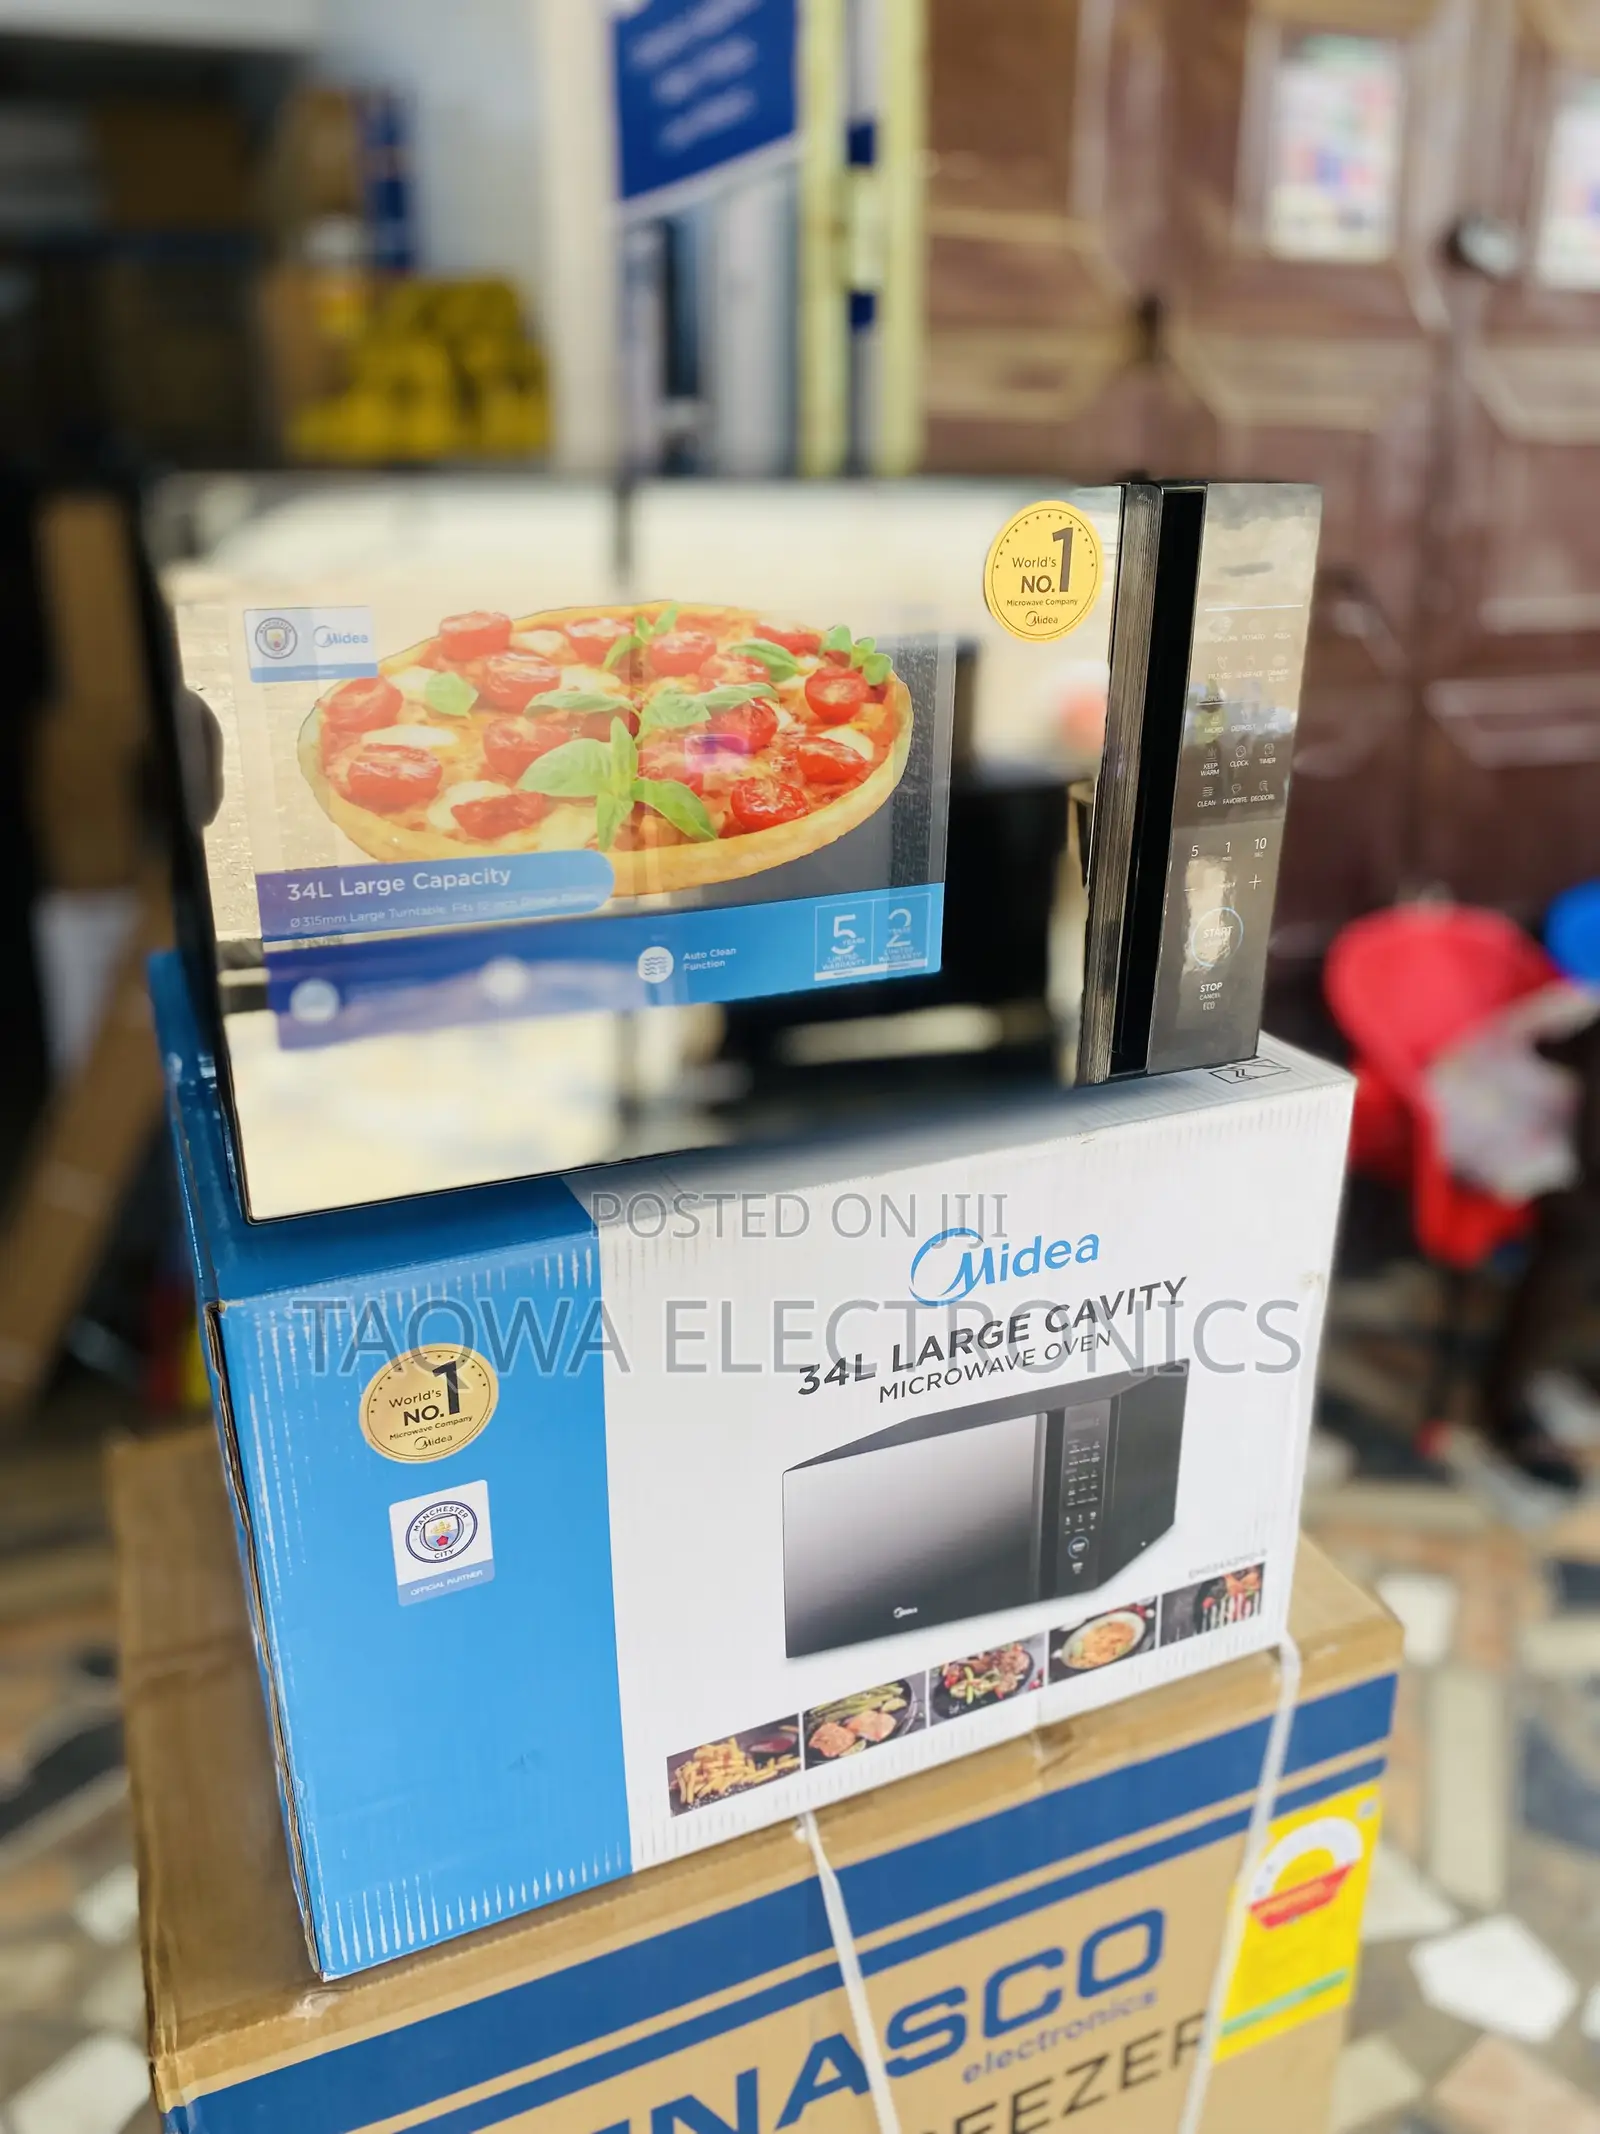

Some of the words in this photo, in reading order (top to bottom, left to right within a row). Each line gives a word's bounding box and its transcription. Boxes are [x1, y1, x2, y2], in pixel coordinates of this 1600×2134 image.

[1012, 557, 1057, 568] World's
[1021, 575, 1055, 594] NO.
[1052, 527, 1074, 593] 1
[1006, 599, 1043, 607] Microwave
[1045, 598, 1078, 606] Company
[1025, 610, 1058, 627] Midea
[1229, 760, 1250, 768] CLOCK
[1197, 800, 1217, 808] CLEAN
[1223, 796, 1248, 804] FAVORITE
[1191, 845, 1199, 857] 5
[1225, 841, 1231, 853] 1
[1254, 837, 1267, 850] 10
[287, 881, 334, 902] 34L
[340, 876, 405, 896] Large
[413, 867, 511, 892] Capacity
[350, 909, 386, 924] Large
[830, 913, 856, 955] 5
[886, 908, 912, 948] 2
[1203, 926, 1234, 939] START
[683, 950, 708, 961] Auto
[709, 946, 737, 958] Clean
[683, 959, 726, 972] Function
[1200, 982, 1223, 993] STOP
[1199, 992, 1221, 1001] CANCEL
[909, 1227, 1100, 1307] Midea
[798, 1353, 876, 1396] 34L
[892, 1313, 1031, 1373] LARGE
[1045, 1277, 1188, 1333] CAVITY
[879, 1349, 1036, 1403] MICROWAVE
[1044, 1330, 1112, 1361] OVEN
[389, 1390, 442, 1408] World's
[403, 1405, 445, 1427] NO.
[432, 1361, 461, 1416] 1
[389, 1425, 433, 1440] Microwave
[435, 1415, 474, 1429] Company
[414, 1435, 453, 1451] Midea
[413, 1505, 470, 1533] MANCHESTER
[434, 1548, 455, 1560] CITY
[410, 1580, 445, 1596] OFFICIAL
[446, 1569, 483, 1586] PARTNER
[962, 1989, 1158, 2084] electronics
